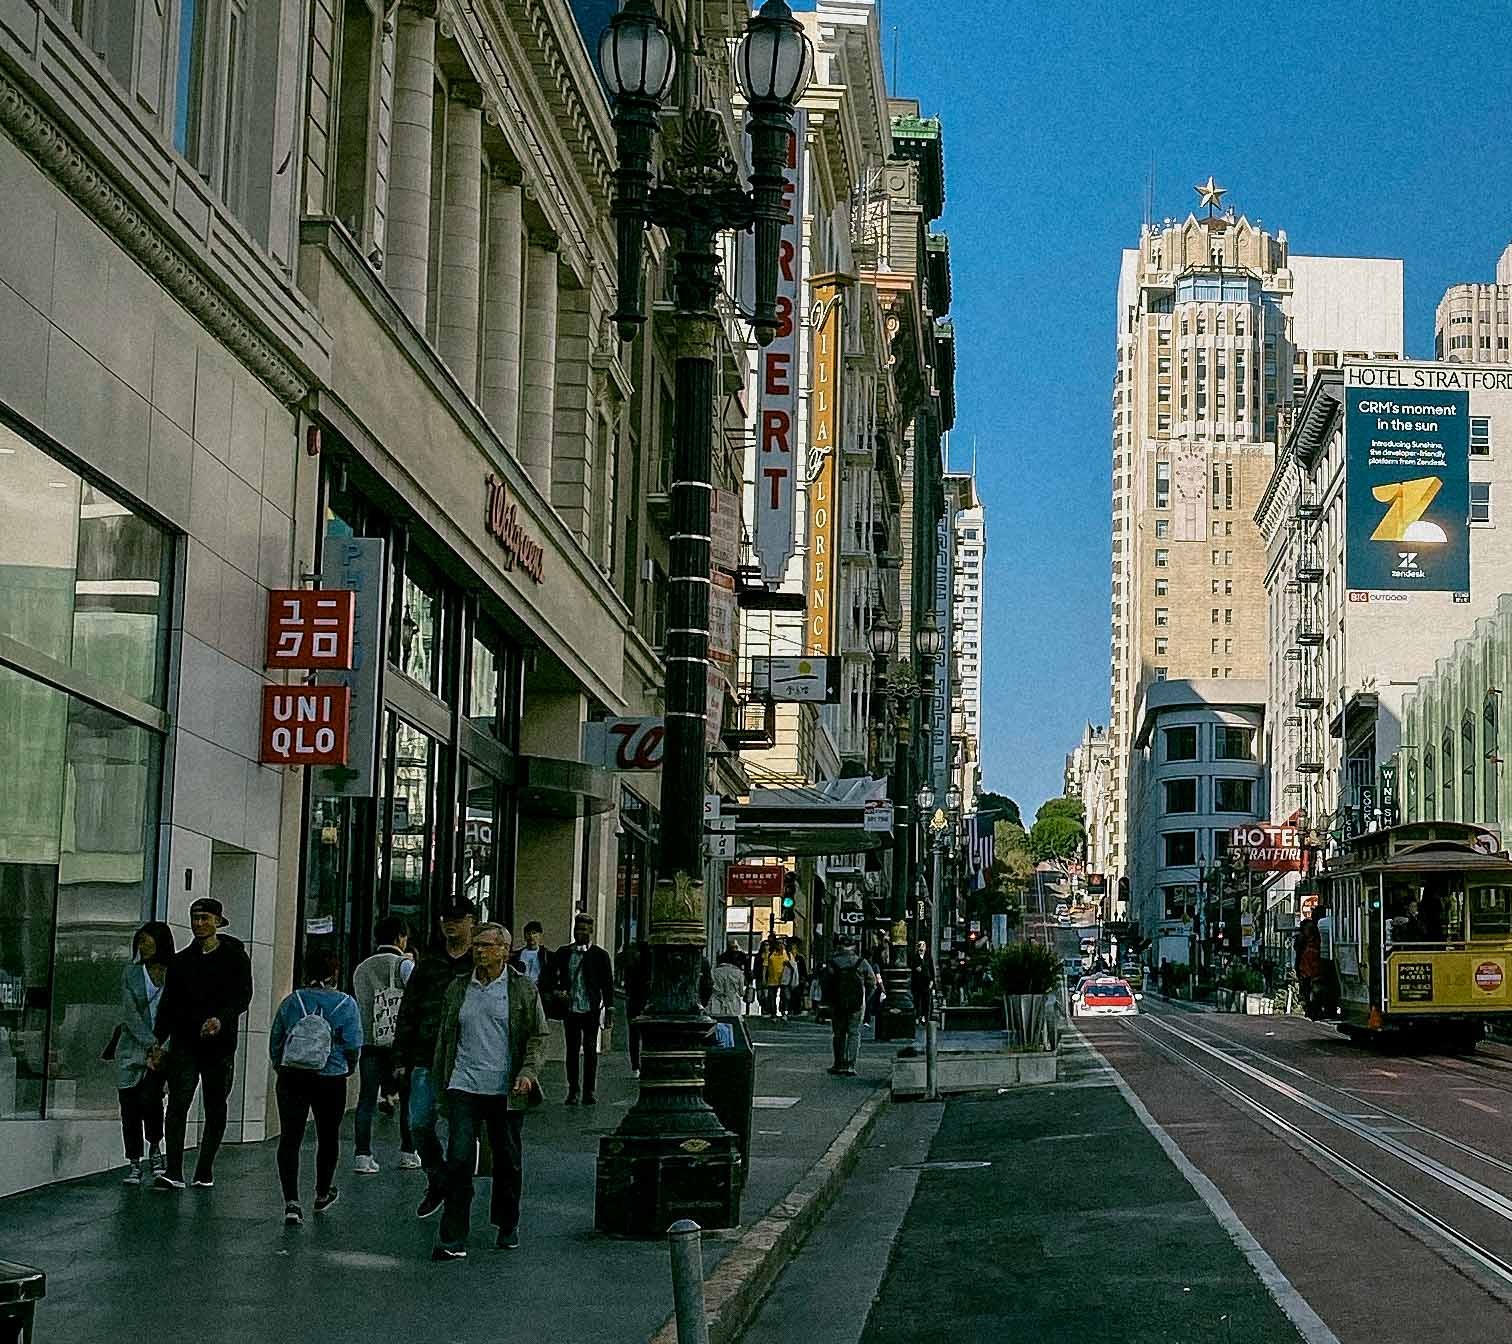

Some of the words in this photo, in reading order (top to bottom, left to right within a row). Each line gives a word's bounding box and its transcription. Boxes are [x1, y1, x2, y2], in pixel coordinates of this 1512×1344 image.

[811, 294, 842, 441] VILLA
[1349, 368, 1408, 387] HOTEL
[1359, 400, 1400, 414] CRM's
[1401, 404, 1457, 416] moment
[1377, 417, 1389, 430] in
[1391, 418, 1412, 431] the
[1415, 422, 1438, 432] sun
[1391, 569, 1426, 578] zendesk
[279, 600, 339, 626] ユニ
[275, 632, 339, 657] クロ
[273, 695, 331, 722] UNI
[271, 727, 335, 758] QLO
[1383, 770, 1394, 805] WINE
[1231, 848, 1301, 861] SRATFOR
